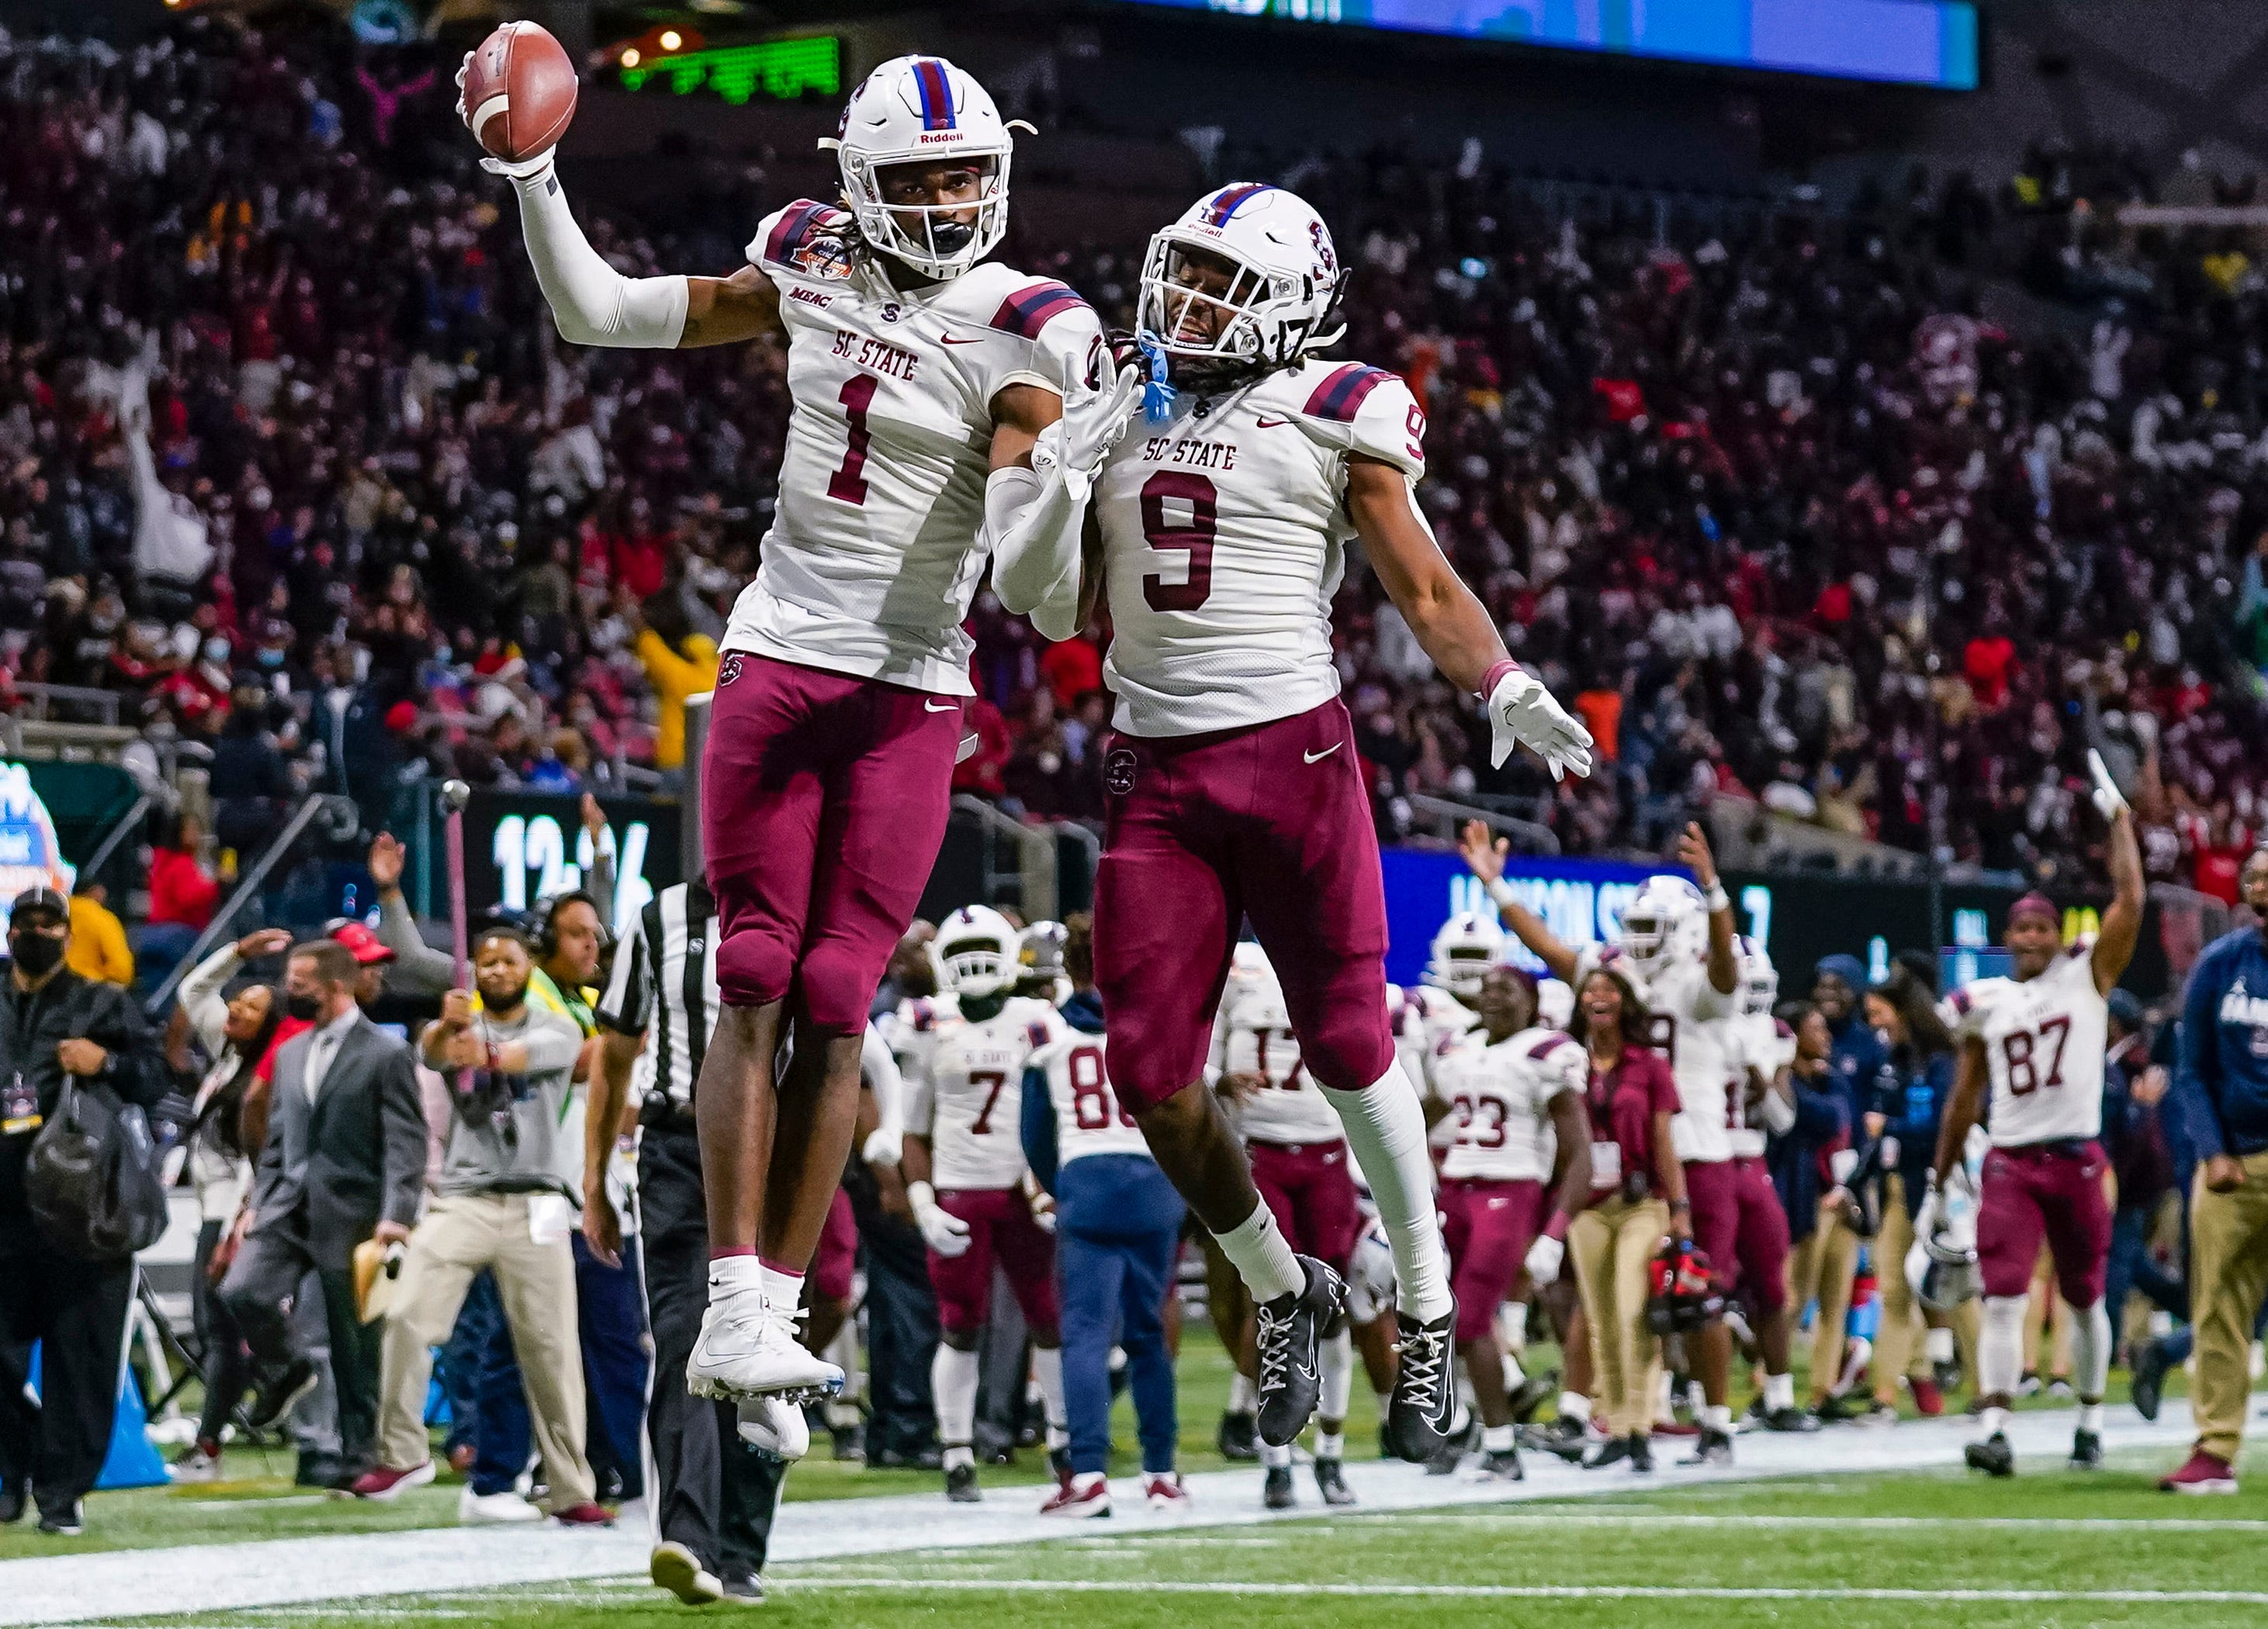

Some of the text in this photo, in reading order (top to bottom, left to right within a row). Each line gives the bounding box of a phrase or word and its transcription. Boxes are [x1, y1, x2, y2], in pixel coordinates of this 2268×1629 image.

[920, 133, 963, 144] Riddell
[789, 286, 833, 308] MEAC
[832, 329, 919, 381] SC STATE
[826, 373, 878, 506] 1
[1142, 438, 1170, 461] SC
[1172, 439, 1237, 470] STATE
[1405, 404, 1425, 462] 9
[1140, 470, 1217, 612] 9
[2003, 1014, 2071, 1095] 87
[969, 1070, 1006, 1135] 7
[1069, 1046, 1137, 1130] 8
